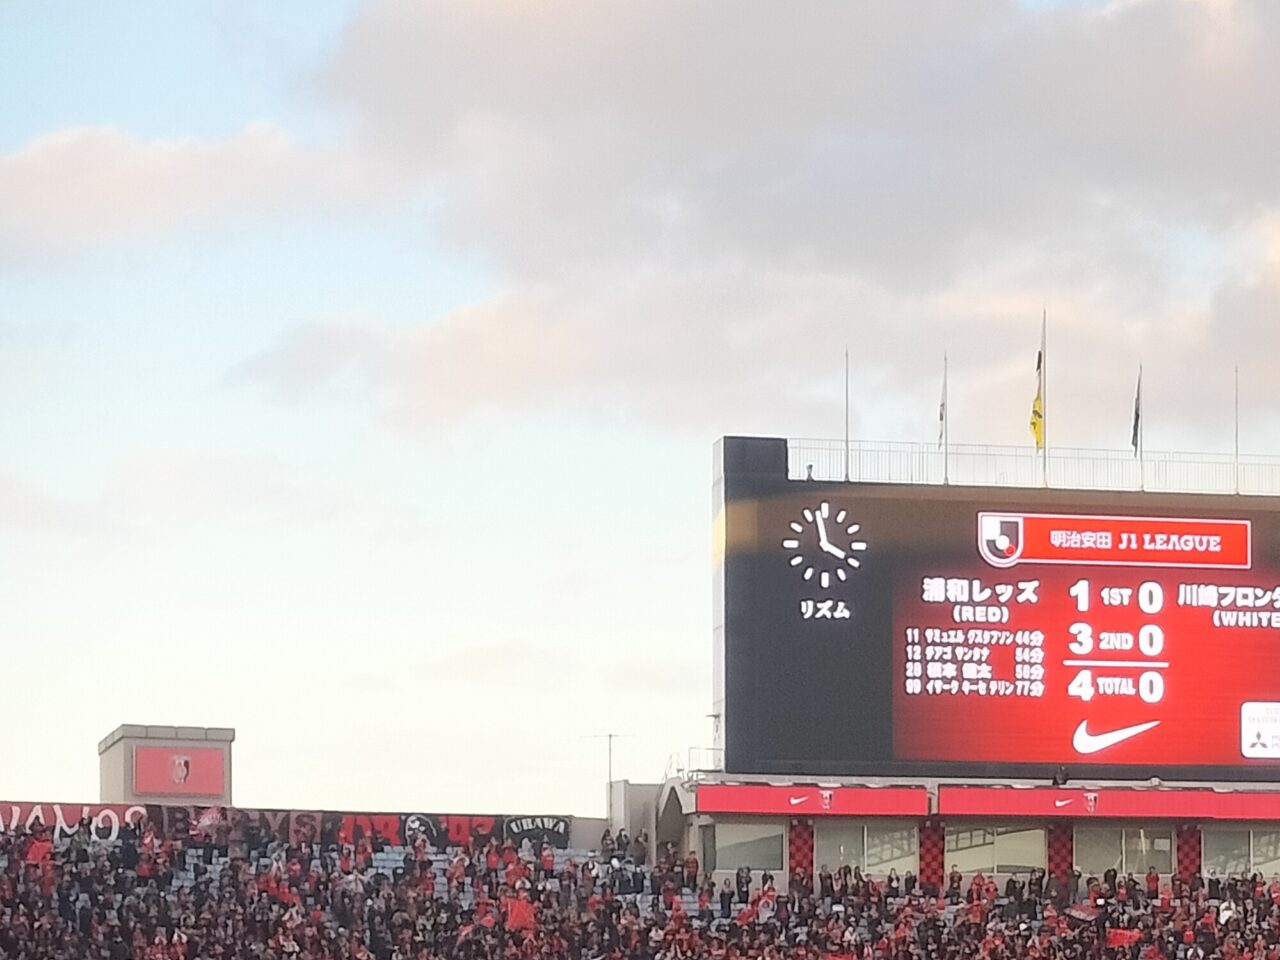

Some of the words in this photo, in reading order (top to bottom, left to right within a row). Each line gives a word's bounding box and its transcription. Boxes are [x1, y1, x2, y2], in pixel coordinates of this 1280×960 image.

[1050, 530, 1112, 549] 明治安田
[1118, 533, 1137, 549] J1
[1143, 535, 1222, 551] LEAGUE
[922, 577, 1040, 603] 浦和レッズ
[1069, 580, 1090, 612] 1
[1100, 587, 1133, 606] 1ST
[1138, 582, 1164, 614] 0
[801, 600, 850, 619] リズム
[953, 605, 1009, 623] (RED)
[906, 628, 919, 643] 11
[1069, 623, 1094, 655] 3
[1099, 632, 1134, 650] 2ND
[1138, 624, 1164, 656] 0
[906, 645, 921, 660] 12
[1067, 669, 1095, 702] 4
[1096, 677, 1136, 695] TOTAL
[1138, 671, 1164, 703] 0
